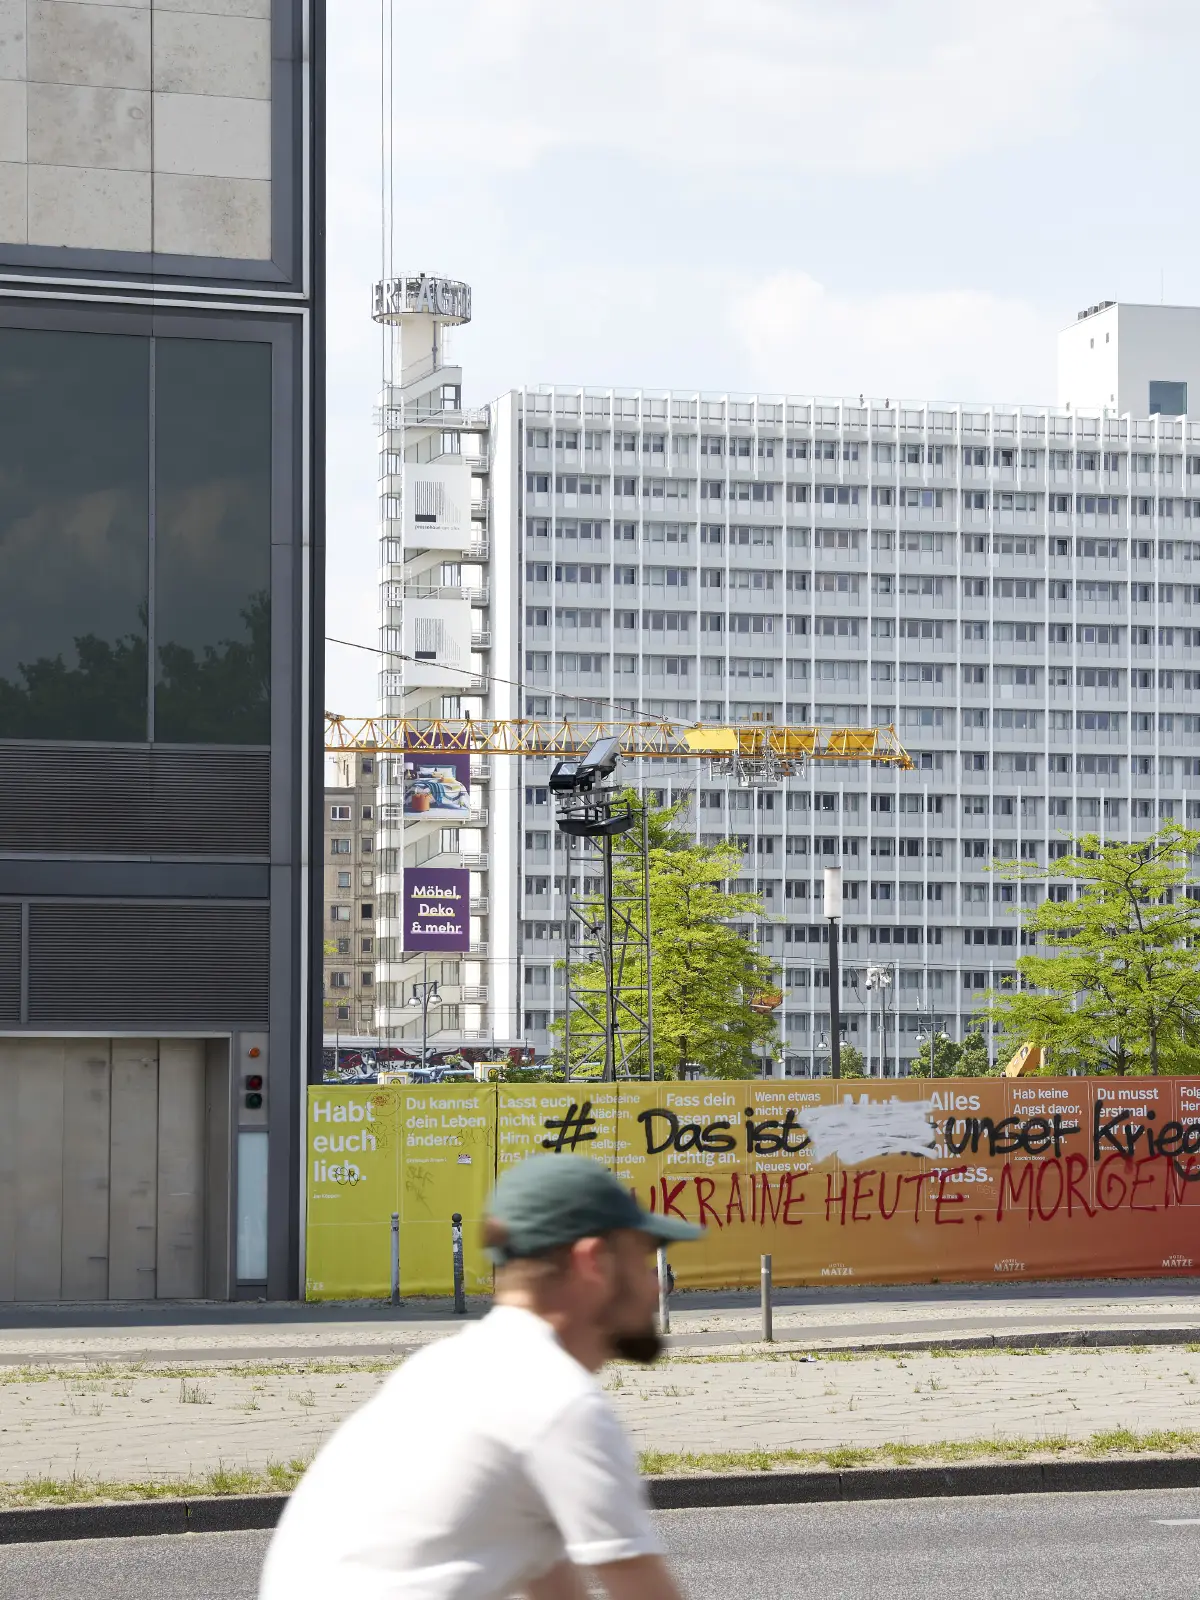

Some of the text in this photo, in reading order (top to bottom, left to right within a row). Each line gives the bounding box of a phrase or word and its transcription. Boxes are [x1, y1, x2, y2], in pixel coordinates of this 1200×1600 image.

[413, 886, 460, 899] Möbel,
[419, 903, 454, 915] Deko
[412, 922, 462, 933] & mehr
[667, 1092, 736, 1107] Fass dein
[755, 1092, 821, 1102] Wenn etwas
[1013, 1088, 1069, 1100] Hab keine
[1097, 1088, 1159, 1100] Du musst
[406, 1097, 479, 1110] Du kannst
[499, 1096, 575, 1109] Lasst euch
[929, 1092, 981, 1111] Alles
[313, 1101, 375, 1122] Habt
[755, 1106, 783, 1116] nicht
[1013, 1104, 1082, 1117] Angst davor,
[406, 1115, 486, 1128] dein Leben
[499, 1113, 537, 1127] nicht
[637, 1108, 737, 1154] Das
[744, 1107, 812, 1154] ist
[313, 1130, 376, 1152] euch
[406, 1134, 462, 1147] ändern.
[499, 1132, 530, 1145] Hirn
[667, 1151, 740, 1166] richtig an.
[313, 1160, 367, 1182] lieb.
[755, 1162, 814, 1172] Neues vor.
[997, 1151, 1197, 1223] MORGEN
[993, 1263, 1026, 1272] MATZE
[1162, 1259, 1193, 1268] MATZE
[821, 1268, 853, 1276] MATZE
